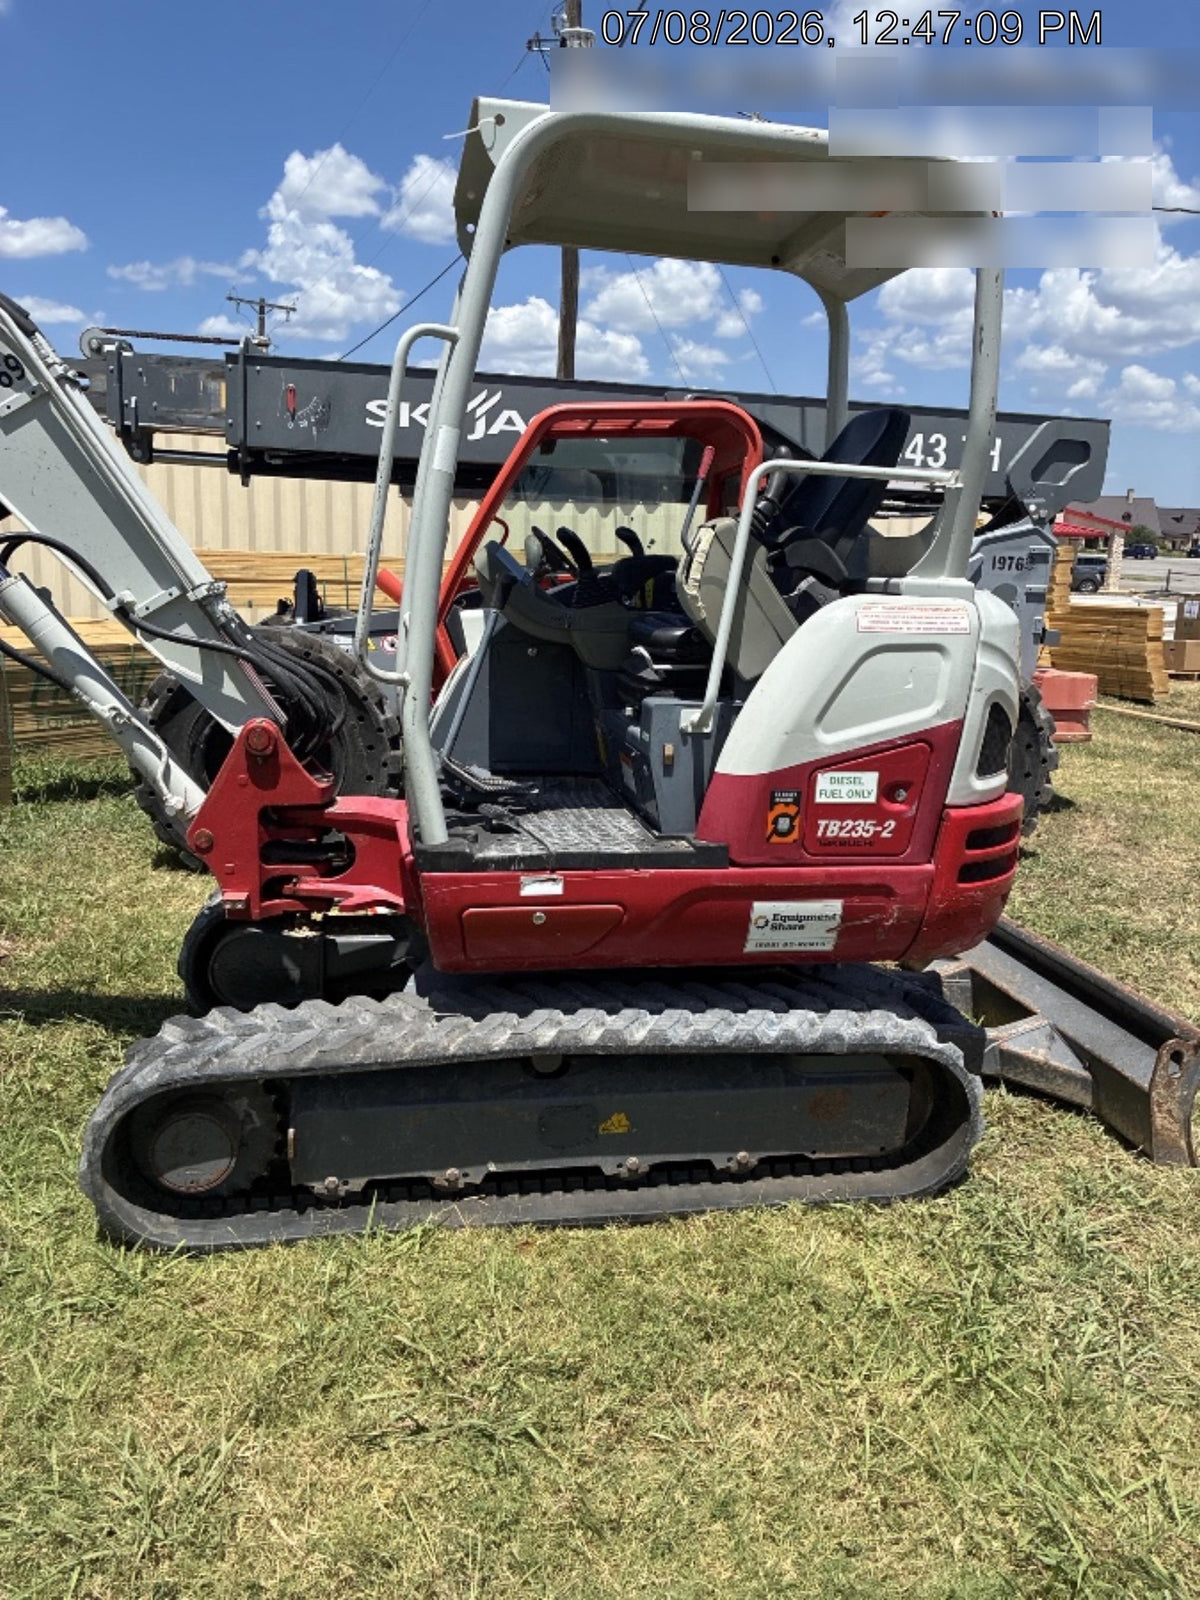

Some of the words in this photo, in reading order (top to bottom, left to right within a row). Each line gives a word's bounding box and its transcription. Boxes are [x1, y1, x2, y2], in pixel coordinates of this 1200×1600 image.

[829, 776, 864, 785] DIESEL
[819, 789, 843, 799] FUEL
[846, 789, 874, 799] ONLY
[816, 820, 896, 838] TB235-2
[772, 913, 838, 923] Equipment
[770, 922, 805, 931] Share
